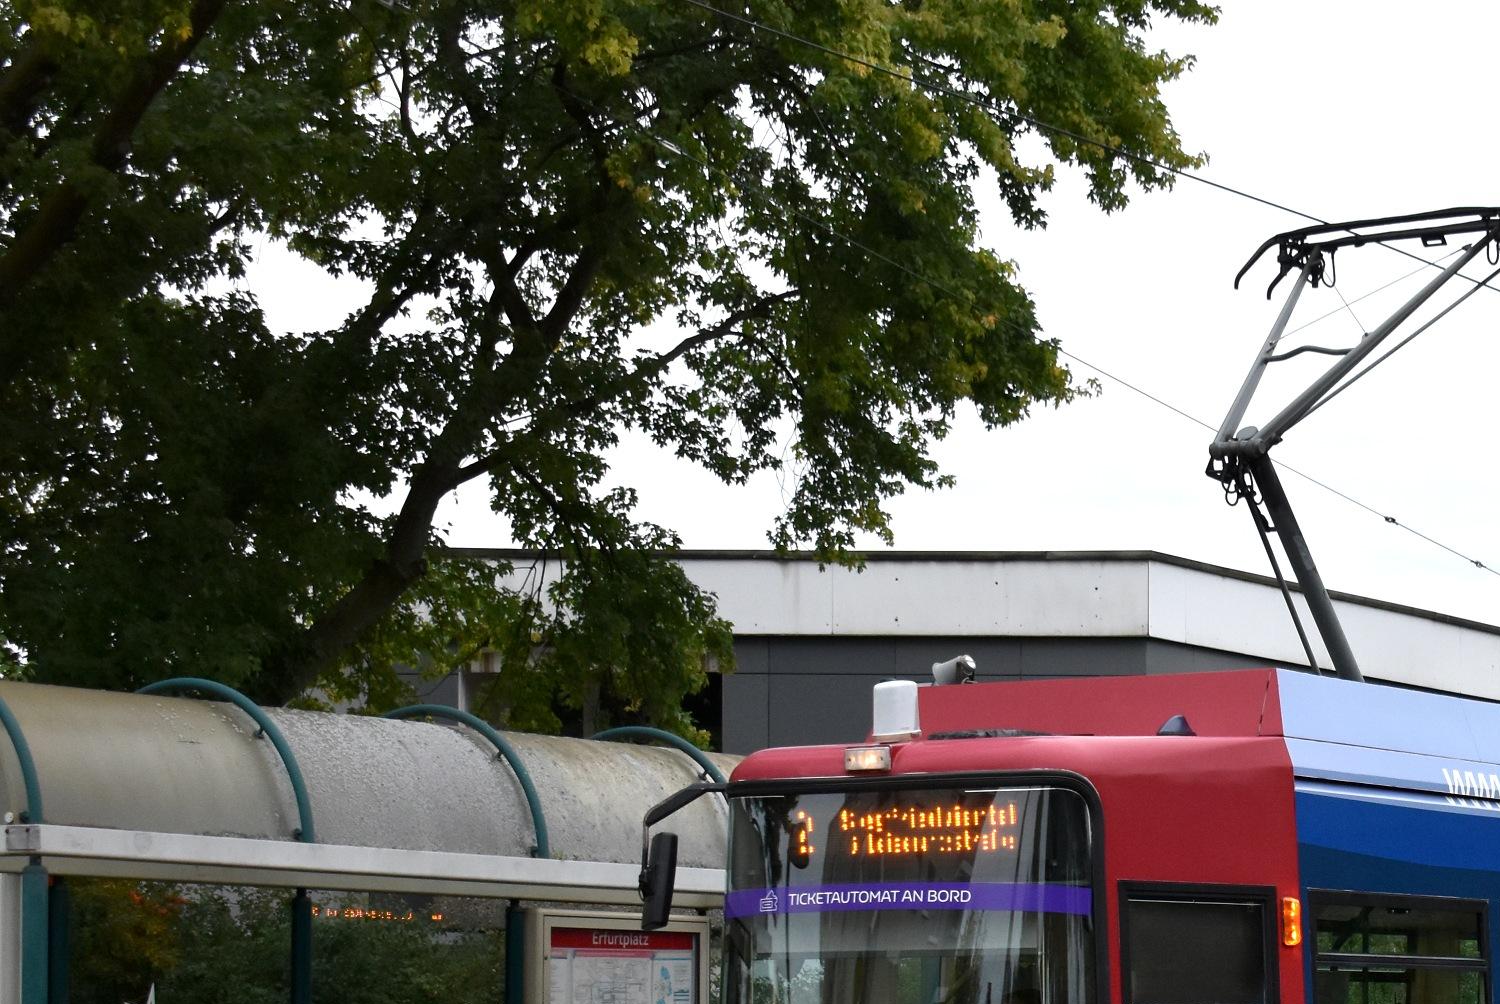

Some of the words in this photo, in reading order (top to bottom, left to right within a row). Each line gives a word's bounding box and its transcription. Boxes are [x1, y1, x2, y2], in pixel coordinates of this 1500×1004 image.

[788, 891, 900, 906] TICKETAUTOMAT
[901, 890, 924, 903] AN
[927, 889, 972, 903] BORD
[592, 931, 649, 949] Erfurtplatz
